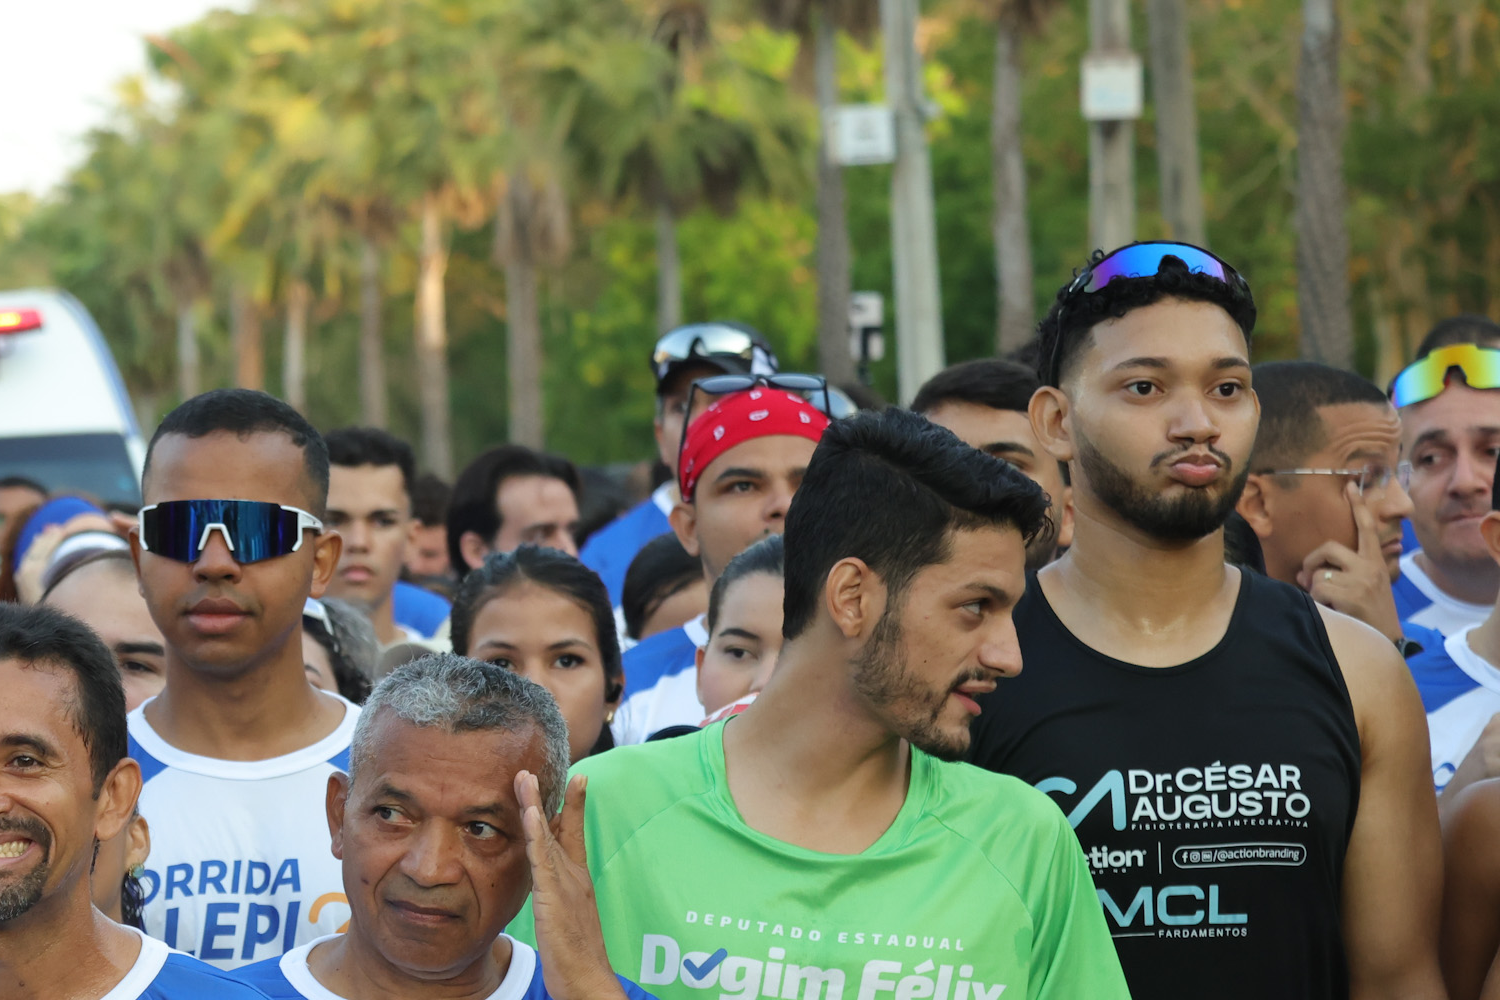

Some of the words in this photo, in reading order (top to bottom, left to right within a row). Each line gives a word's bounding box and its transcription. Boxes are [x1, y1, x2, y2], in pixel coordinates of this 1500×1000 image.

[1131, 790, 1311, 822] AUGUSTO
[1131, 821, 1223, 831] FISIOTERAPIA
[1096, 884, 1248, 927] MCL
[164, 901, 301, 960] LEPI
[685, 911, 821, 942] DEPUTADO
[838, 931, 965, 952] ESTADUAL
[1158, 927, 1247, 938] FARDAMENTOS
